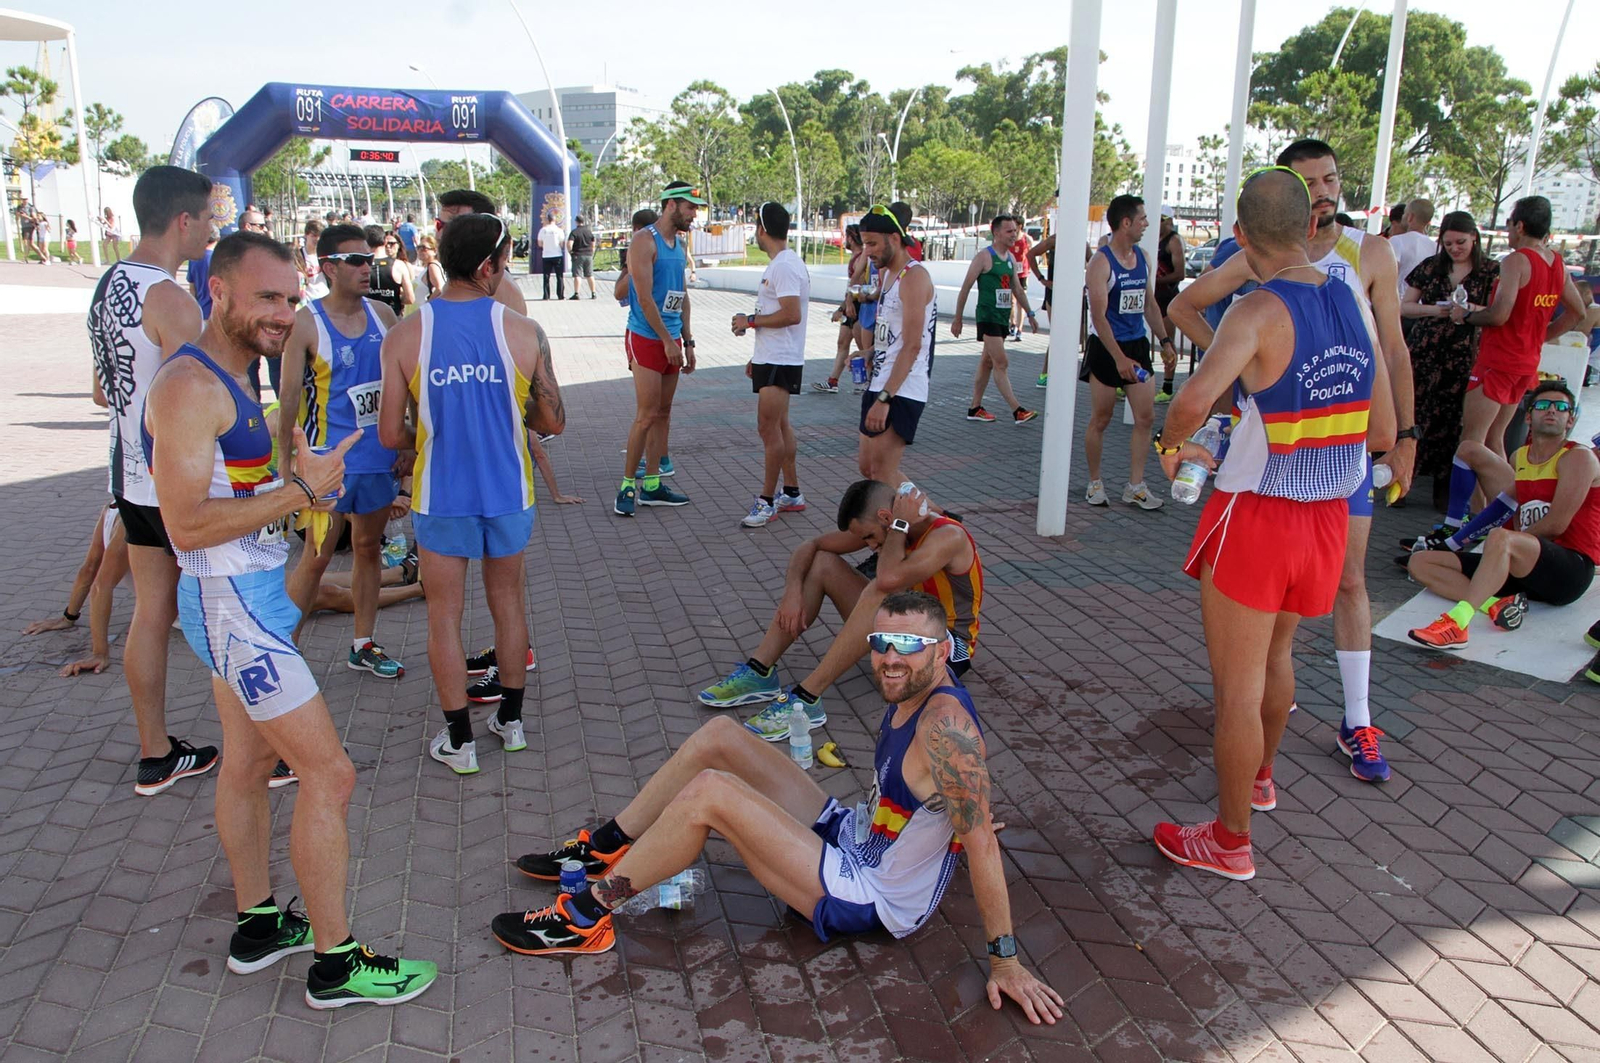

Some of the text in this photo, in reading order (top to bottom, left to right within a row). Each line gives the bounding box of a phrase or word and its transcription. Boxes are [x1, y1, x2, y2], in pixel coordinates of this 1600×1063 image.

[296, 88, 323, 97] RUTA
[330, 93, 418, 111] CARRERA
[451, 95, 478, 104] RUTA
[296, 95, 322, 122] 091
[452, 103, 476, 129] 091
[346, 115, 445, 134] SOLIDARIA
[360, 151, 394, 161] 0:36:40
[1121, 294, 1144, 311] 3245
[1296, 345, 1369, 382] J.S.P. ANDALUCÍA
[429, 364, 502, 387] CAPOL
[1309, 381, 1354, 401] POLICÍA
